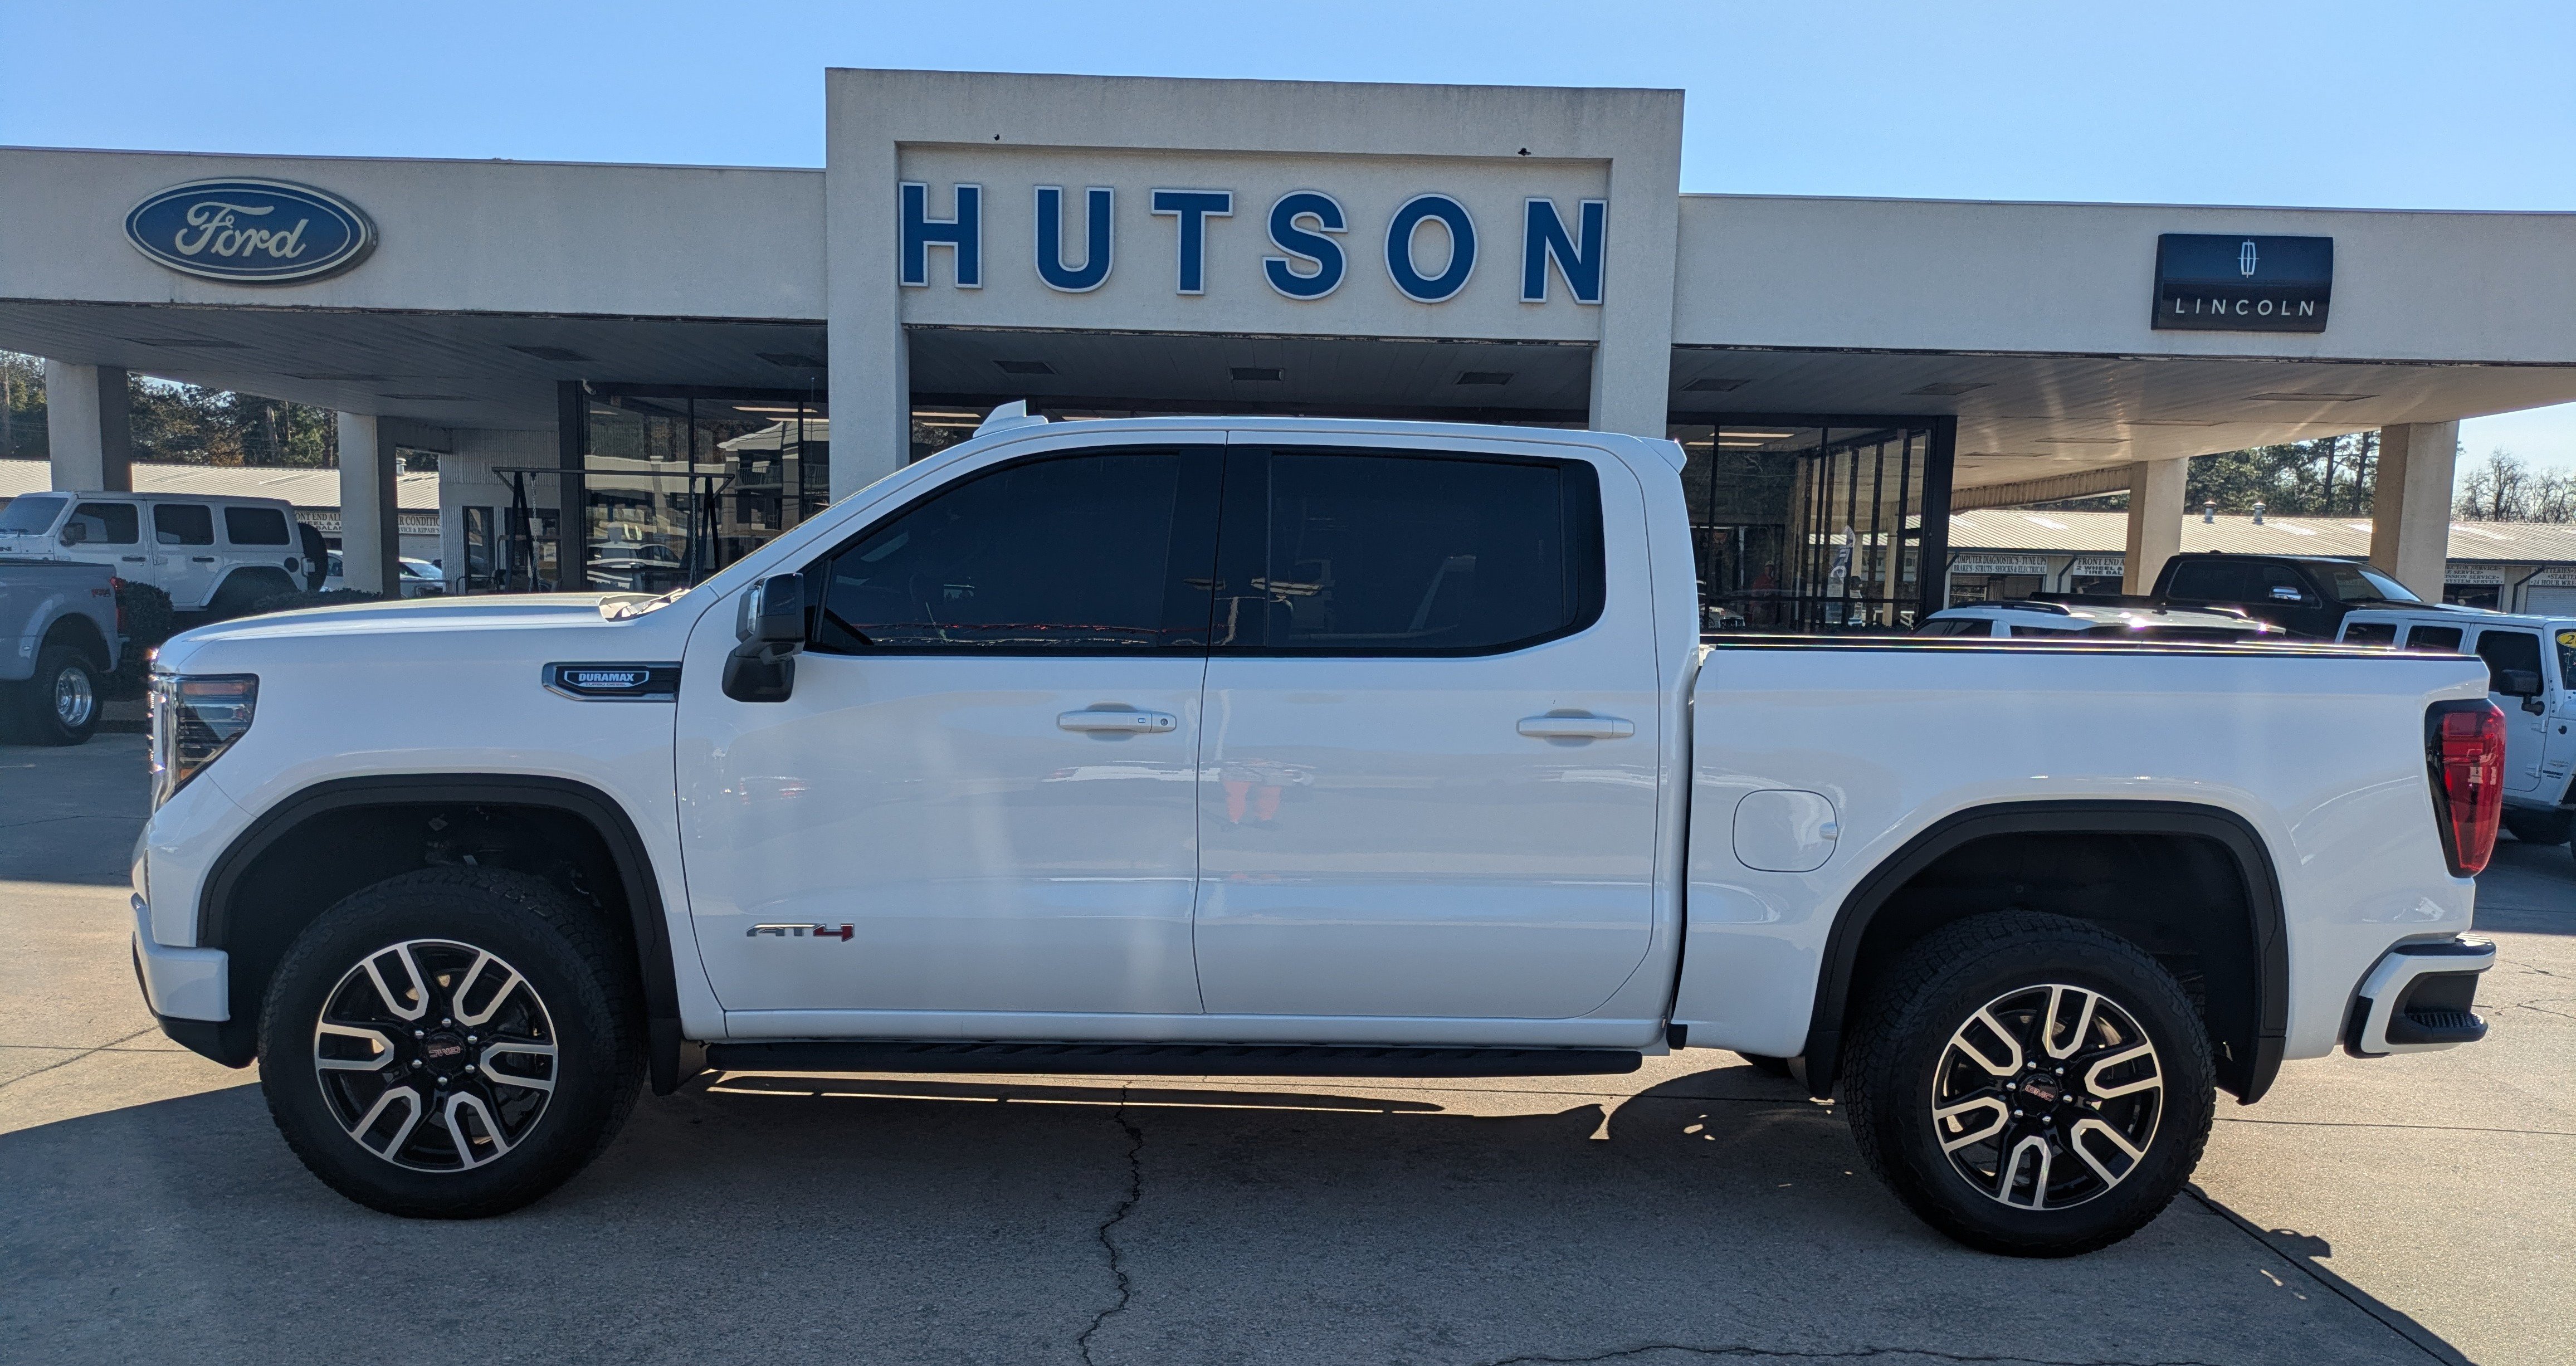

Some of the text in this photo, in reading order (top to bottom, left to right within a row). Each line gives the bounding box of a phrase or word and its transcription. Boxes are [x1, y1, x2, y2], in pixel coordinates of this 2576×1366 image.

[175, 202, 309, 258] Ford
[899, 182, 1608, 304] HUTSON
[2175, 298, 2314, 316] LINCOLN
[747, 923, 855, 942] AT4
[428, 1046, 461, 1058] GMC
[2024, 1084, 2054, 1102] GMC
